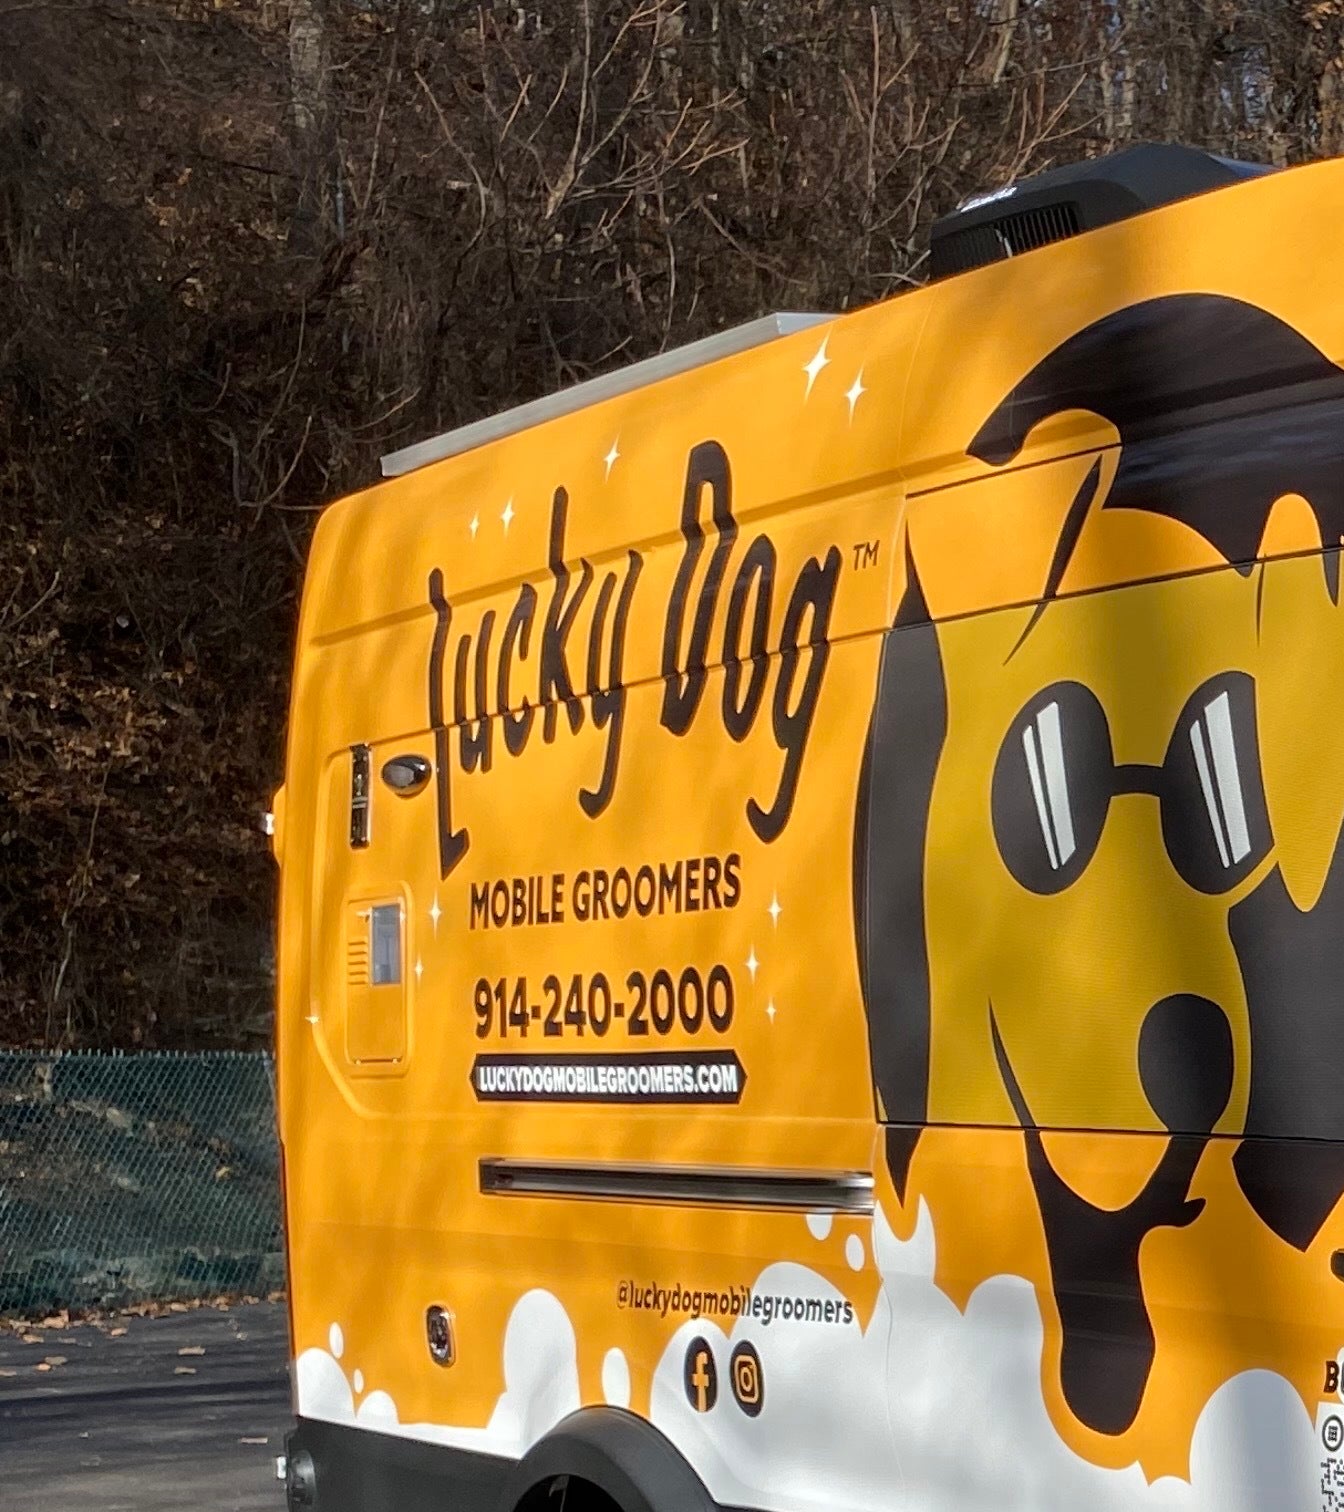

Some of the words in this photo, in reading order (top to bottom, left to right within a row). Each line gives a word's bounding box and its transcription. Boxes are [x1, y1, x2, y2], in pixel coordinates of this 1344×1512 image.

[428, 485, 643, 880] Lucky
[660, 439, 842, 843] Dog
[470, 873, 564, 930] MOBILE
[572, 853, 742, 922] GROOMERS
[474, 964, 735, 1040] 914-240-2000
[479, 1065, 738, 1093] LUCKYDOGMOBILEGROOMERS.COM
[617, 1279, 853, 1326] @luckydogmobilegroomers
